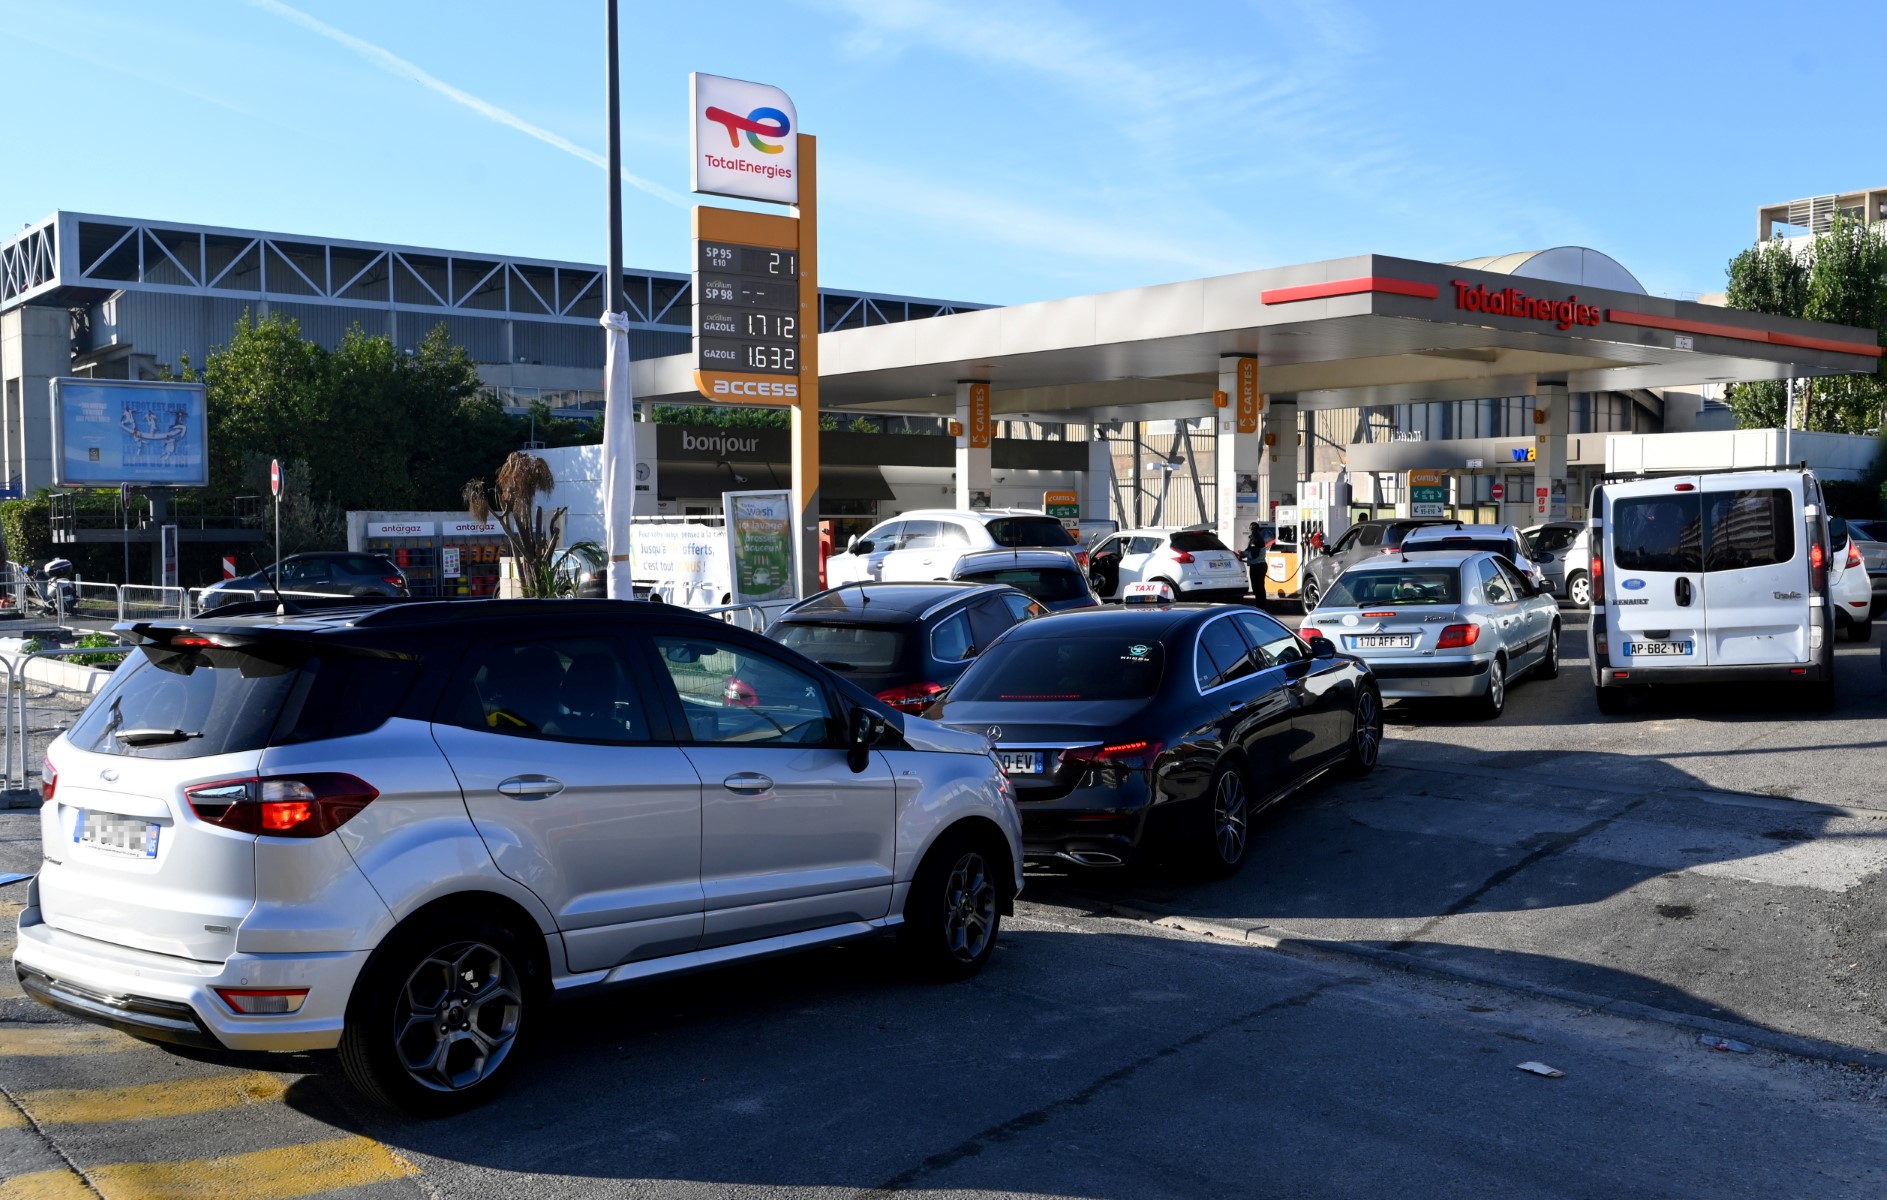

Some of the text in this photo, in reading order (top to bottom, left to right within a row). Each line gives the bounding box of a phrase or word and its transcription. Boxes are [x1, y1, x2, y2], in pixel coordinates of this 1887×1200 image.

[705, 154, 792, 178] TotalEnergies
[706, 248, 732, 259] SP 95
[706, 288, 733, 300] SP 98
[1452, 280, 1600, 330] TotalEnergies
[704, 322, 736, 332] GAZOLE
[704, 350, 736, 359] GAZOLE
[714, 380, 797, 396] access
[1244, 364, 1253, 414] CARTES
[976, 388, 984, 432] CARTES
[682, 431, 759, 456] bonjour
[747, 506, 774, 516] wash
[382, 525, 421, 534] antargaz
[456, 523, 494, 532] antargaz
[641, 543, 666, 556] Jusqu'à
[683, 543, 714, 556] offerts,
[1773, 591, 1801, 600] Trafic
[1360, 636, 1409, 646] 170 AFF 13
[1631, 642, 1684, 654] AP-682-TV
[1000, 754, 1032, 769] 0-EV
